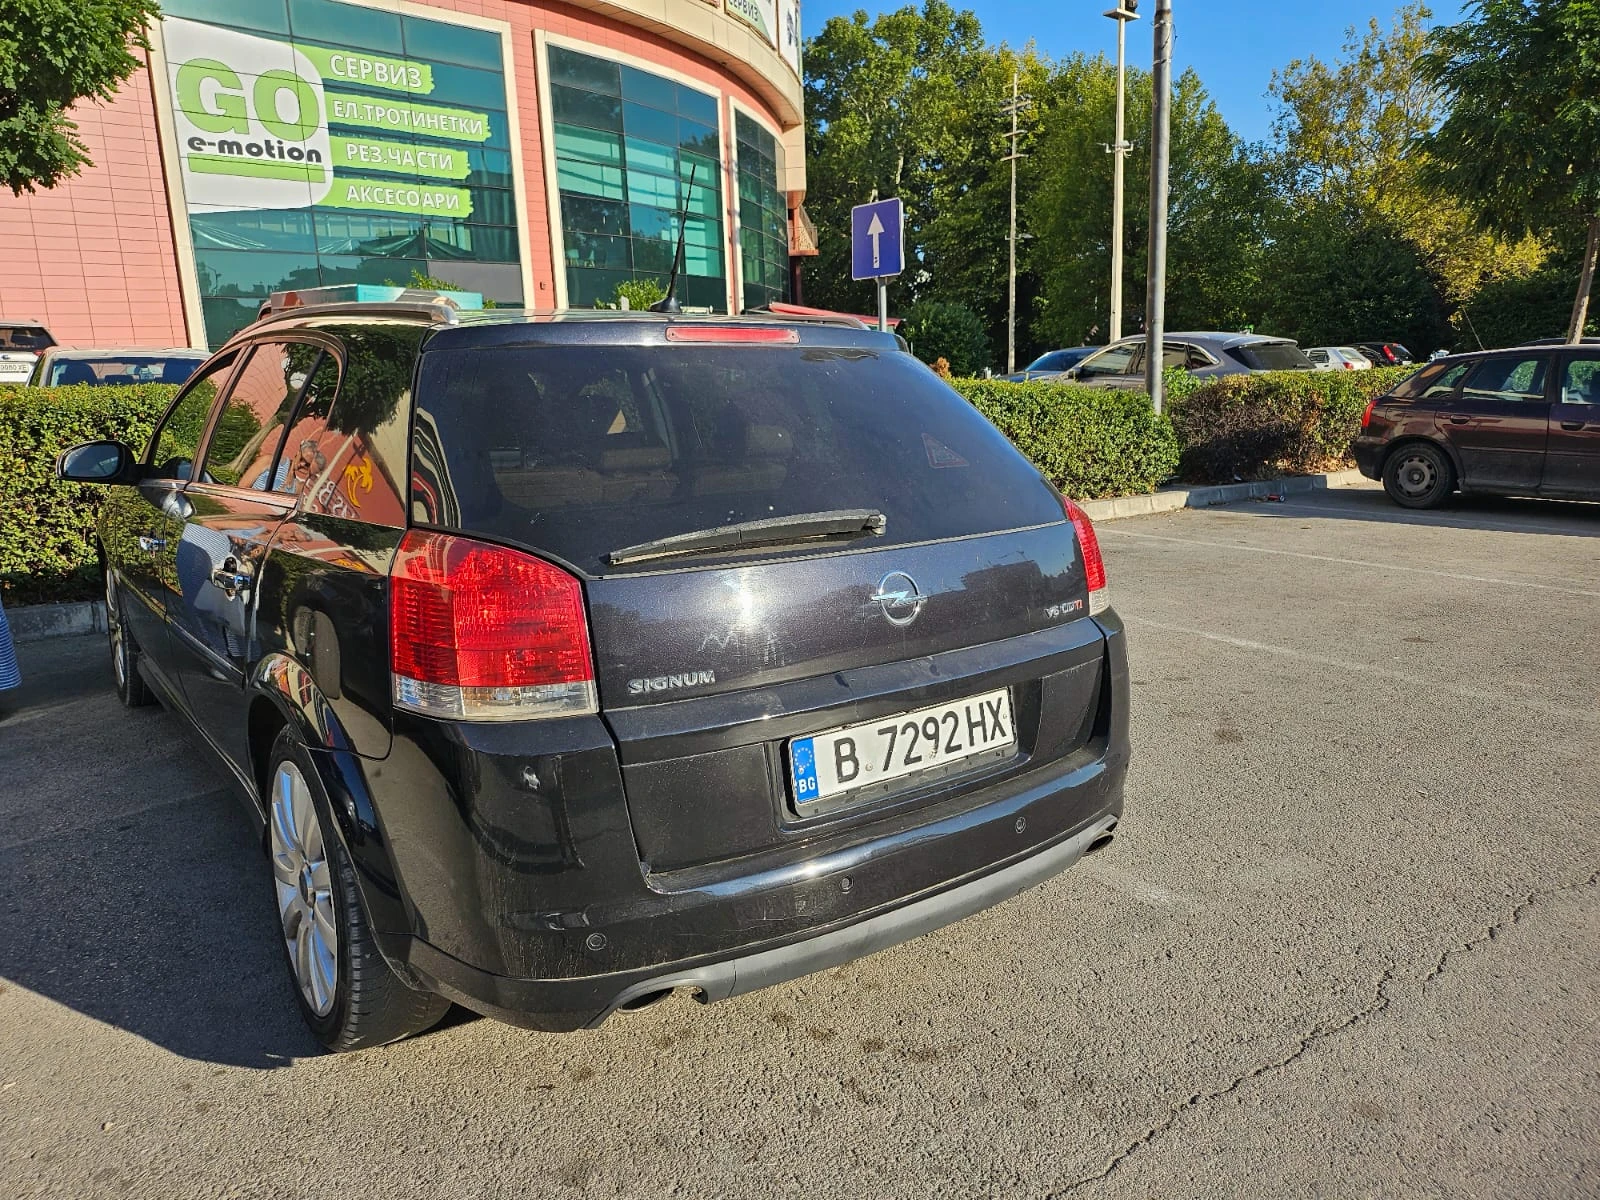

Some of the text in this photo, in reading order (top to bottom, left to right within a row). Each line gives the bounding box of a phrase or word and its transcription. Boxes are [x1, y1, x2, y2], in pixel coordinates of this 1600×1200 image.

[330, 55, 422, 88] СЕРВИЗ
[176, 58, 320, 142] GO
[333, 101, 483, 135] ЕЛ.ТРОТИНЕТКИ
[187, 136, 322, 163] e-motion
[346, 143, 453, 170] РЕЗ.ЧАСТИ
[346, 185, 459, 210] АКСЕСОАРИ
[628, 669, 715, 694] SIGNUM
[834, 697, 1007, 784] B 7292 HX
[799, 776, 816, 794] BG
